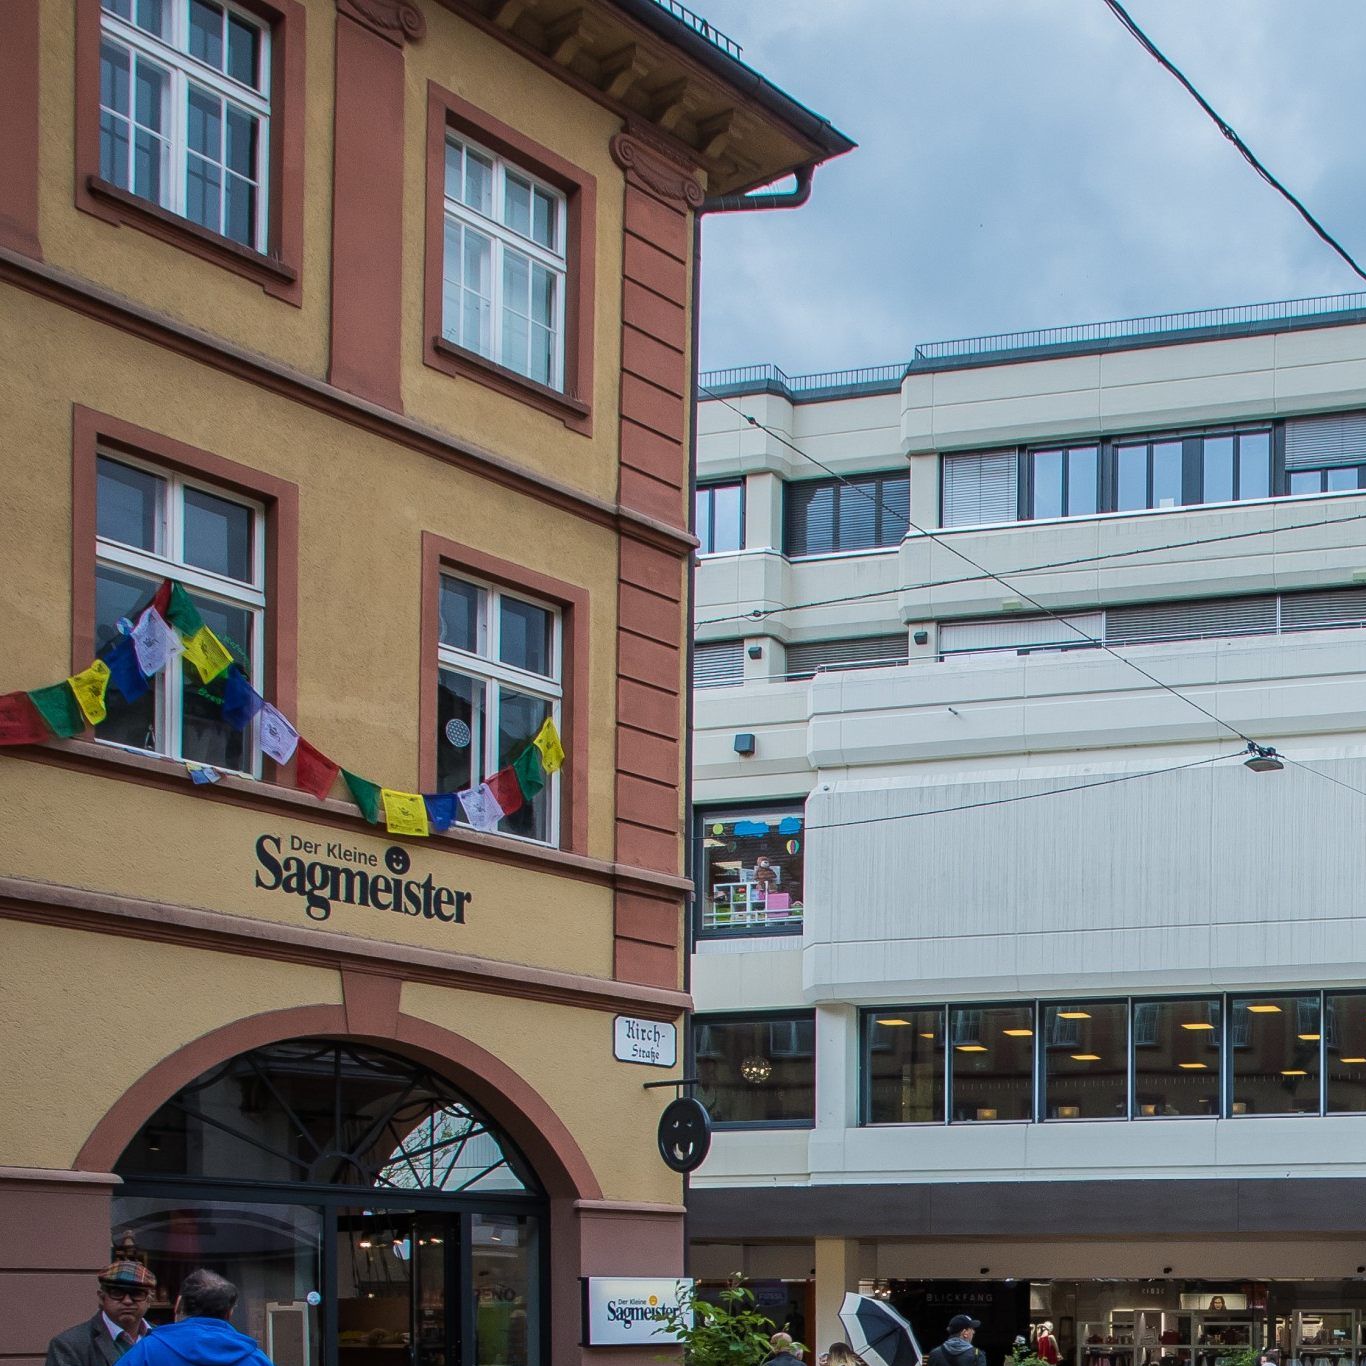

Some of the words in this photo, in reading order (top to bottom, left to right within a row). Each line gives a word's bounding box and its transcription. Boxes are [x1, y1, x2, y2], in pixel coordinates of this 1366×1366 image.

[290, 835, 321, 854] Der
[327, 842, 378, 867] Kleine
[255, 834, 472, 925] Sagmeister
[625, 1019, 666, 1047] Kirch-
[927, 1293, 993, 1302] BLICKFANG
[607, 1300, 679, 1329] Sagmeister
